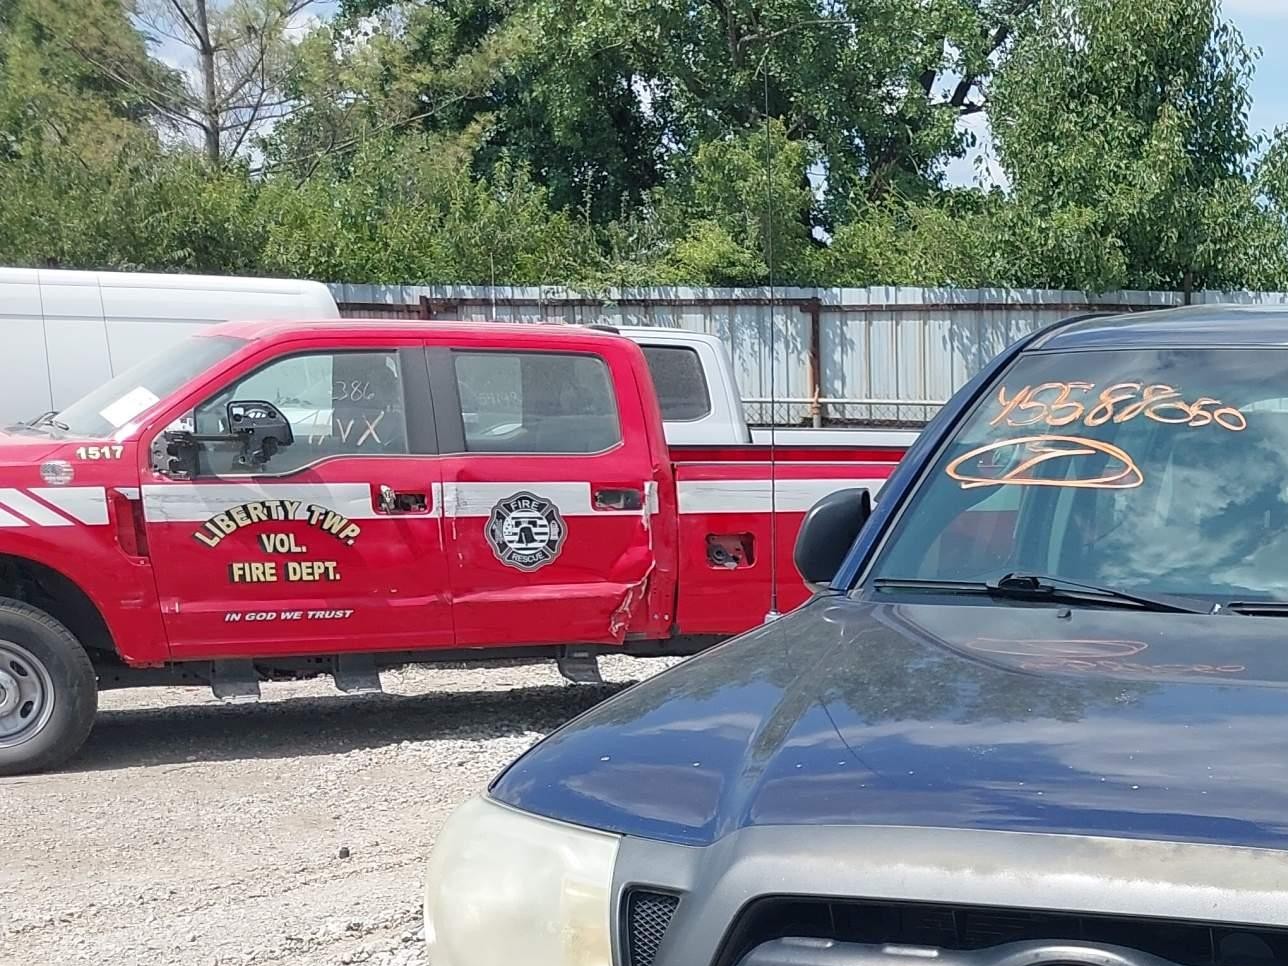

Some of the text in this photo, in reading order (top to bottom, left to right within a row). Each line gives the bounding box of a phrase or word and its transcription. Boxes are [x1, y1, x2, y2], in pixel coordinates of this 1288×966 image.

[76, 445, 124, 460] 1517
[510, 499, 541, 511] FIRE
[193, 499, 361, 548] LIBERTY TWP.
[259, 532, 308, 553] VOL.
[511, 551, 545, 563] RESCUE
[229, 560, 342, 583] FIRE DEPT.
[224, 609, 354, 622] IN GOD WE TRUST
